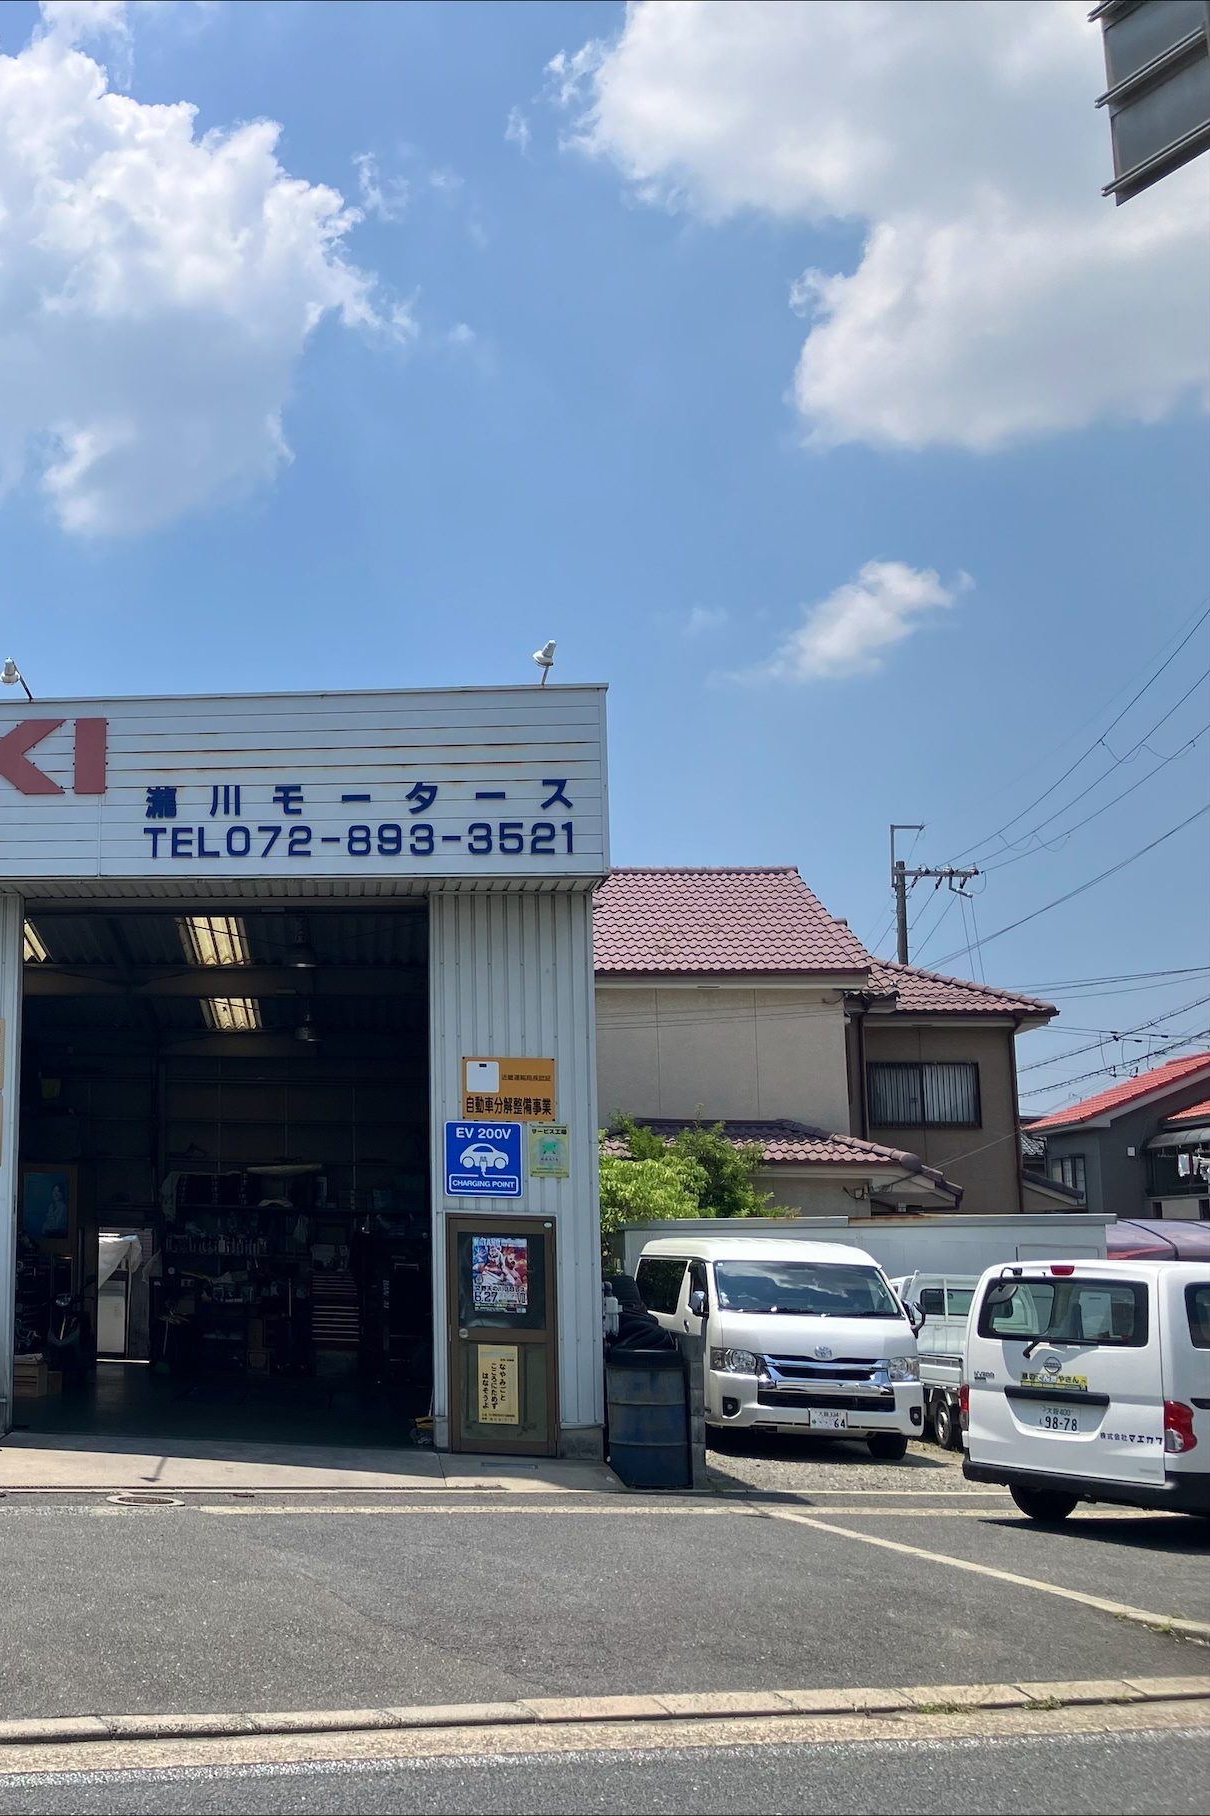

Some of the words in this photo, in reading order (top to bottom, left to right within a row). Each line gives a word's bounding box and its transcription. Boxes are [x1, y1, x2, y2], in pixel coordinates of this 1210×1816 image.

[466, 1096, 552, 1116] 自動車分解整備事業
[455, 1127, 474, 1139] EV
[477, 1128, 512, 1140] 200V
[452, 1180, 491, 1188] CHARGING
[1044, 1416, 1078, 1431] 98-78
